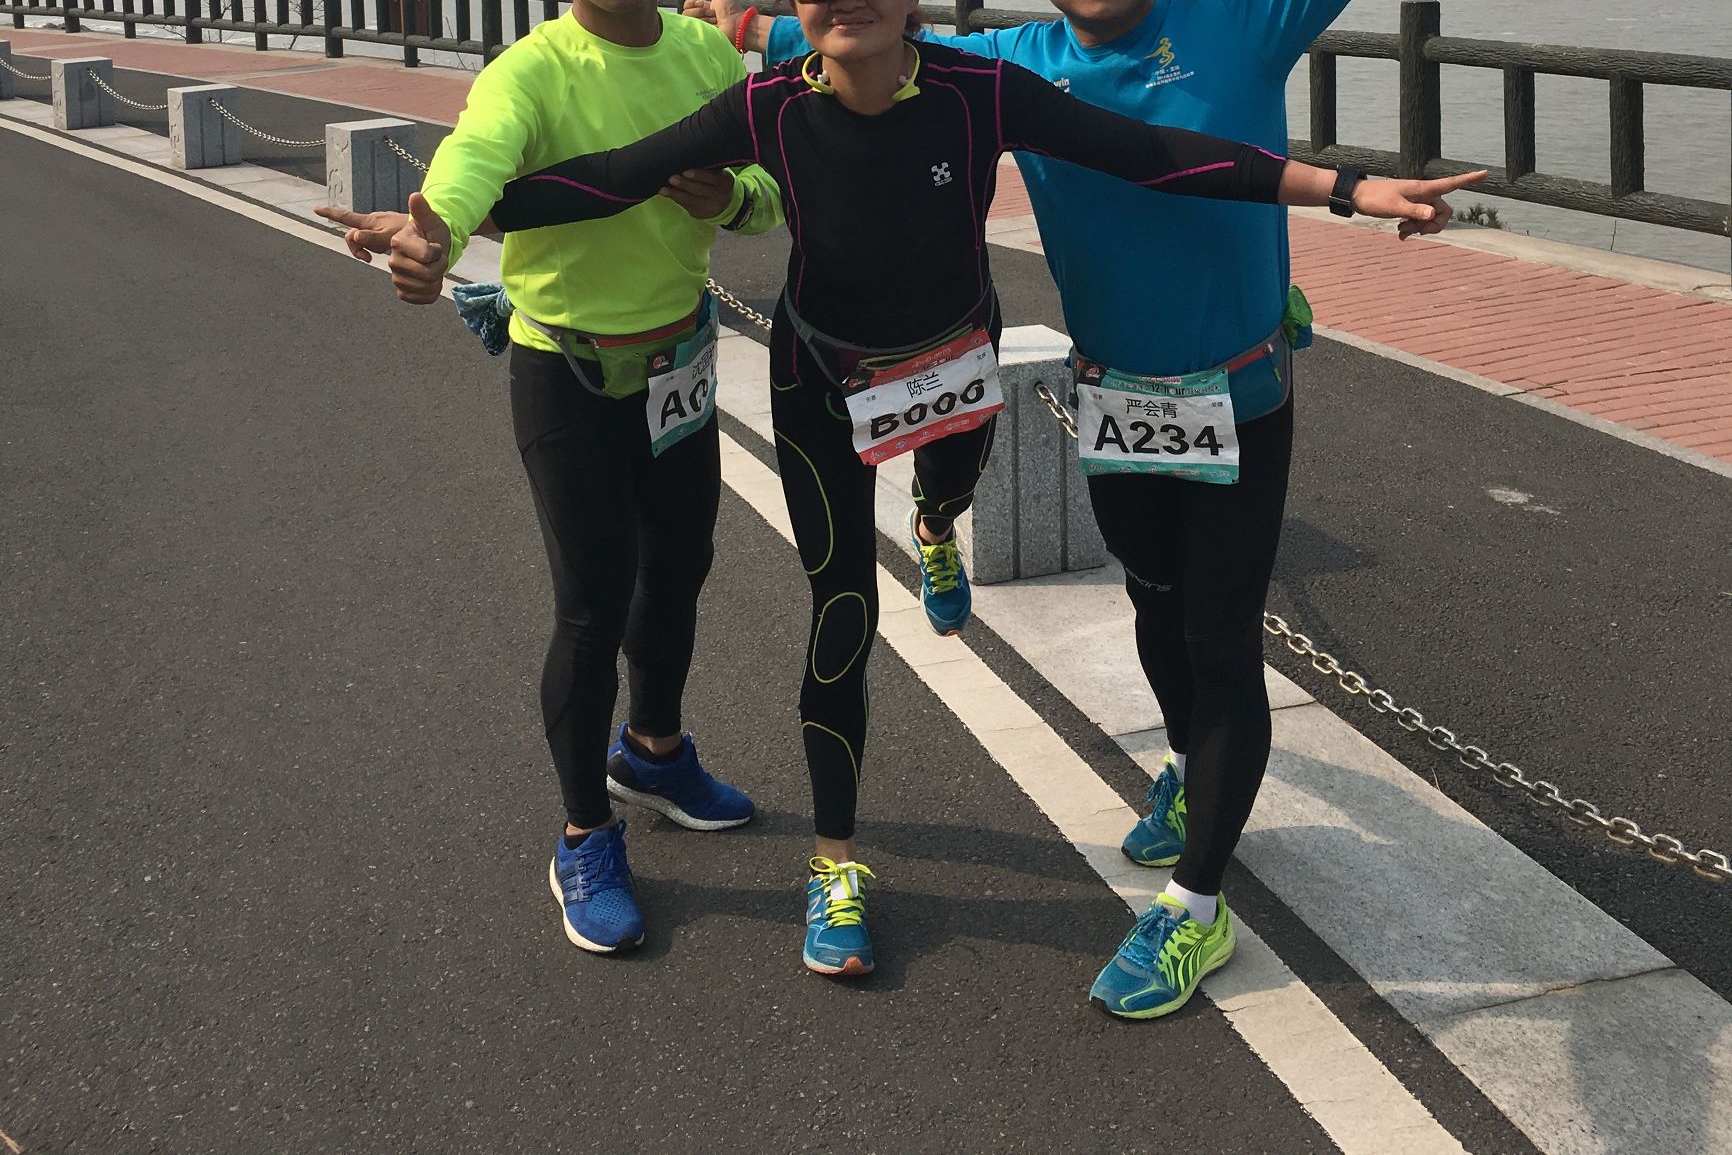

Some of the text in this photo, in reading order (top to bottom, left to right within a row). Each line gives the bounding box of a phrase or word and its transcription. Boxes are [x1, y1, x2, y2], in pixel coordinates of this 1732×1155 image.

[906, 371, 943, 399] 陈兰
[1125, 397, 1178, 419] 严会青
[1093, 413, 1224, 457] A234
